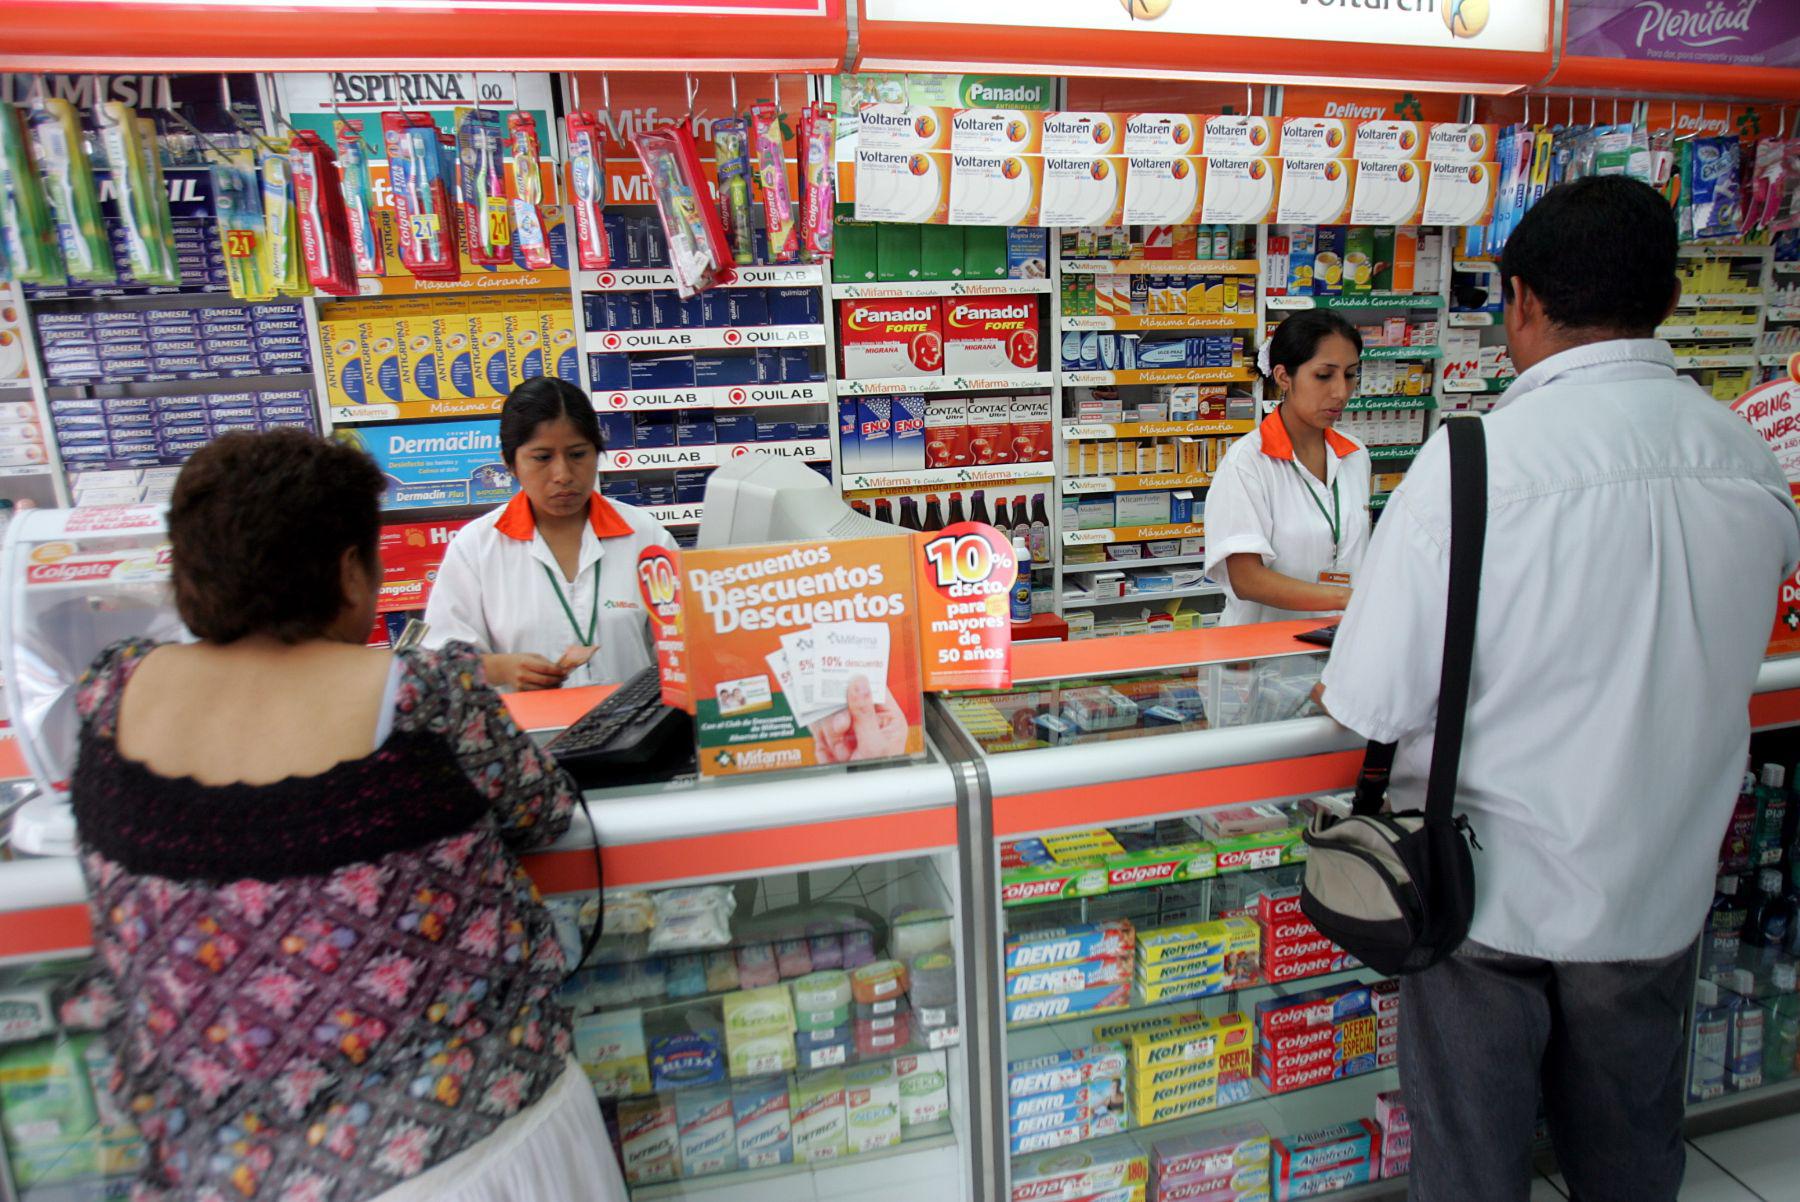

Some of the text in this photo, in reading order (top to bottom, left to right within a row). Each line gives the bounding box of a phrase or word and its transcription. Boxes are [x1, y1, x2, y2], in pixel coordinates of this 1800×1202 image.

[1635, 0, 1757, 48] Plenitud
[334, 72, 465, 105] ASPIRINA
[971, 83, 1041, 102] Panadol
[1324, 101, 1386, 120] Delivery
[860, 113, 912, 126] Voltaren
[953, 118, 1003, 132] Voltaren
[1677, 114, 1728, 133] Delivery
[1044, 121, 1090, 135] Voltaren
[1127, 123, 1170, 135] Voltaren
[1206, 124, 1247, 137] Voltaren
[1283, 126, 1323, 138] Voltaren
[1357, 129, 1397, 141] Voltaren
[1430, 131, 1467, 143] Voltaren
[860, 151, 908, 164] Voltaren
[954, 156, 1001, 168] Voltaren
[1047, 158, 1090, 171] Voltaren
[1130, 157, 1171, 169] Voltaren
[1209, 158, 1249, 170] Voltaren
[1286, 160, 1325, 171] Voltaren
[1360, 161, 1398, 173] Voltaren
[1433, 163, 1468, 174] Voltaren
[768, 189, 779, 231] Colgate
[809, 187, 818, 228] Colgate
[578, 200, 588, 241] Colgate
[303, 219, 316, 261] Colgate
[621, 275, 676, 286] QUILA
[743, 271, 807, 282] QUILAB
[861, 288, 903, 297] Mifarma
[966, 285, 1007, 294] Mifarma
[204, 308, 243, 318] LAMISIL
[258, 305, 295, 315] LAMISIL
[855, 305, 931, 323] Panadol
[956, 304, 1029, 320] Panadol
[207, 324, 246, 334] LAMISIL
[260, 321, 298, 330] LAMISIL
[886, 323, 928, 333] FORTE
[985, 321, 1025, 330] FORTE
[263, 337, 300, 346] LAMISIL
[626, 335, 692, 346] QUILAB
[746, 331, 809, 342] QUILAB
[396, 320, 410, 384] ANTIGRIPINA
[432, 319, 447, 381] ANTIGRIPINA
[469, 317, 482, 380] ANTIGRIPINA
[505, 316, 518, 378] ANTIGRIPINA
[541, 314, 553, 377] ANTIGRIPINA
[213, 355, 251, 365] LAMISIL
[265, 352, 303, 361] LAMISIL
[321, 325, 337, 388] ANTIGRIPINA
[359, 323, 374, 385] ANTIGRIPINA
[264, 391, 301, 401] LAMISIL
[633, 394, 697, 405] QUILAB
[752, 389, 813, 401] QUILAB
[266, 406, 304, 416] LAMISIL
[924, 406, 965, 415] CONTAC
[968, 404, 1007, 414] CONTAC
[1011, 403, 1049, 412] CONTAC
[862, 418, 890, 434] ENO
[895, 418, 923, 432] ENO
[389, 430, 493, 454] Dermaclín
[638, 452, 701, 464] QUILAB
[870, 477, 911, 487] Mifarma
[972, 470, 1011, 480] Mifarma
[31, 563, 112, 582] Colgate
[688, 546, 831, 592] Descuentos
[702, 563, 884, 613] Descuentos
[949, 580, 1008, 597] dscto.
[714, 592, 905, 634] Descuentos
[947, 602, 986, 618] para
[932, 616, 1004, 634] mayores
[958, 631, 980, 645] de
[938, 645, 1004, 663] 50 años
[1112, 862, 1172, 883] Colgate
[1015, 940, 1081, 967] DENTO
[1160, 940, 1209, 957] Kolynos
[1275, 940, 1330, 958] Colgate
[1160, 960, 1208, 978] Kolynos
[1274, 957, 1330, 977] Colgate
[1159, 979, 1208, 997] Kolynos
[1343, 1019, 1374, 1037] OFERTA
[1277, 1029, 1332, 1050] Colgate
[1343, 1036, 1374, 1057] ESPECIAL
[1277, 1047, 1332, 1069] Colgate
[1153, 1058, 1216, 1083] Kolynos
[1277, 1066, 1331, 1086] Colgate
[1153, 1077, 1215, 1102] Kolynos
[1153, 1095, 1214, 1120] Kolynos
